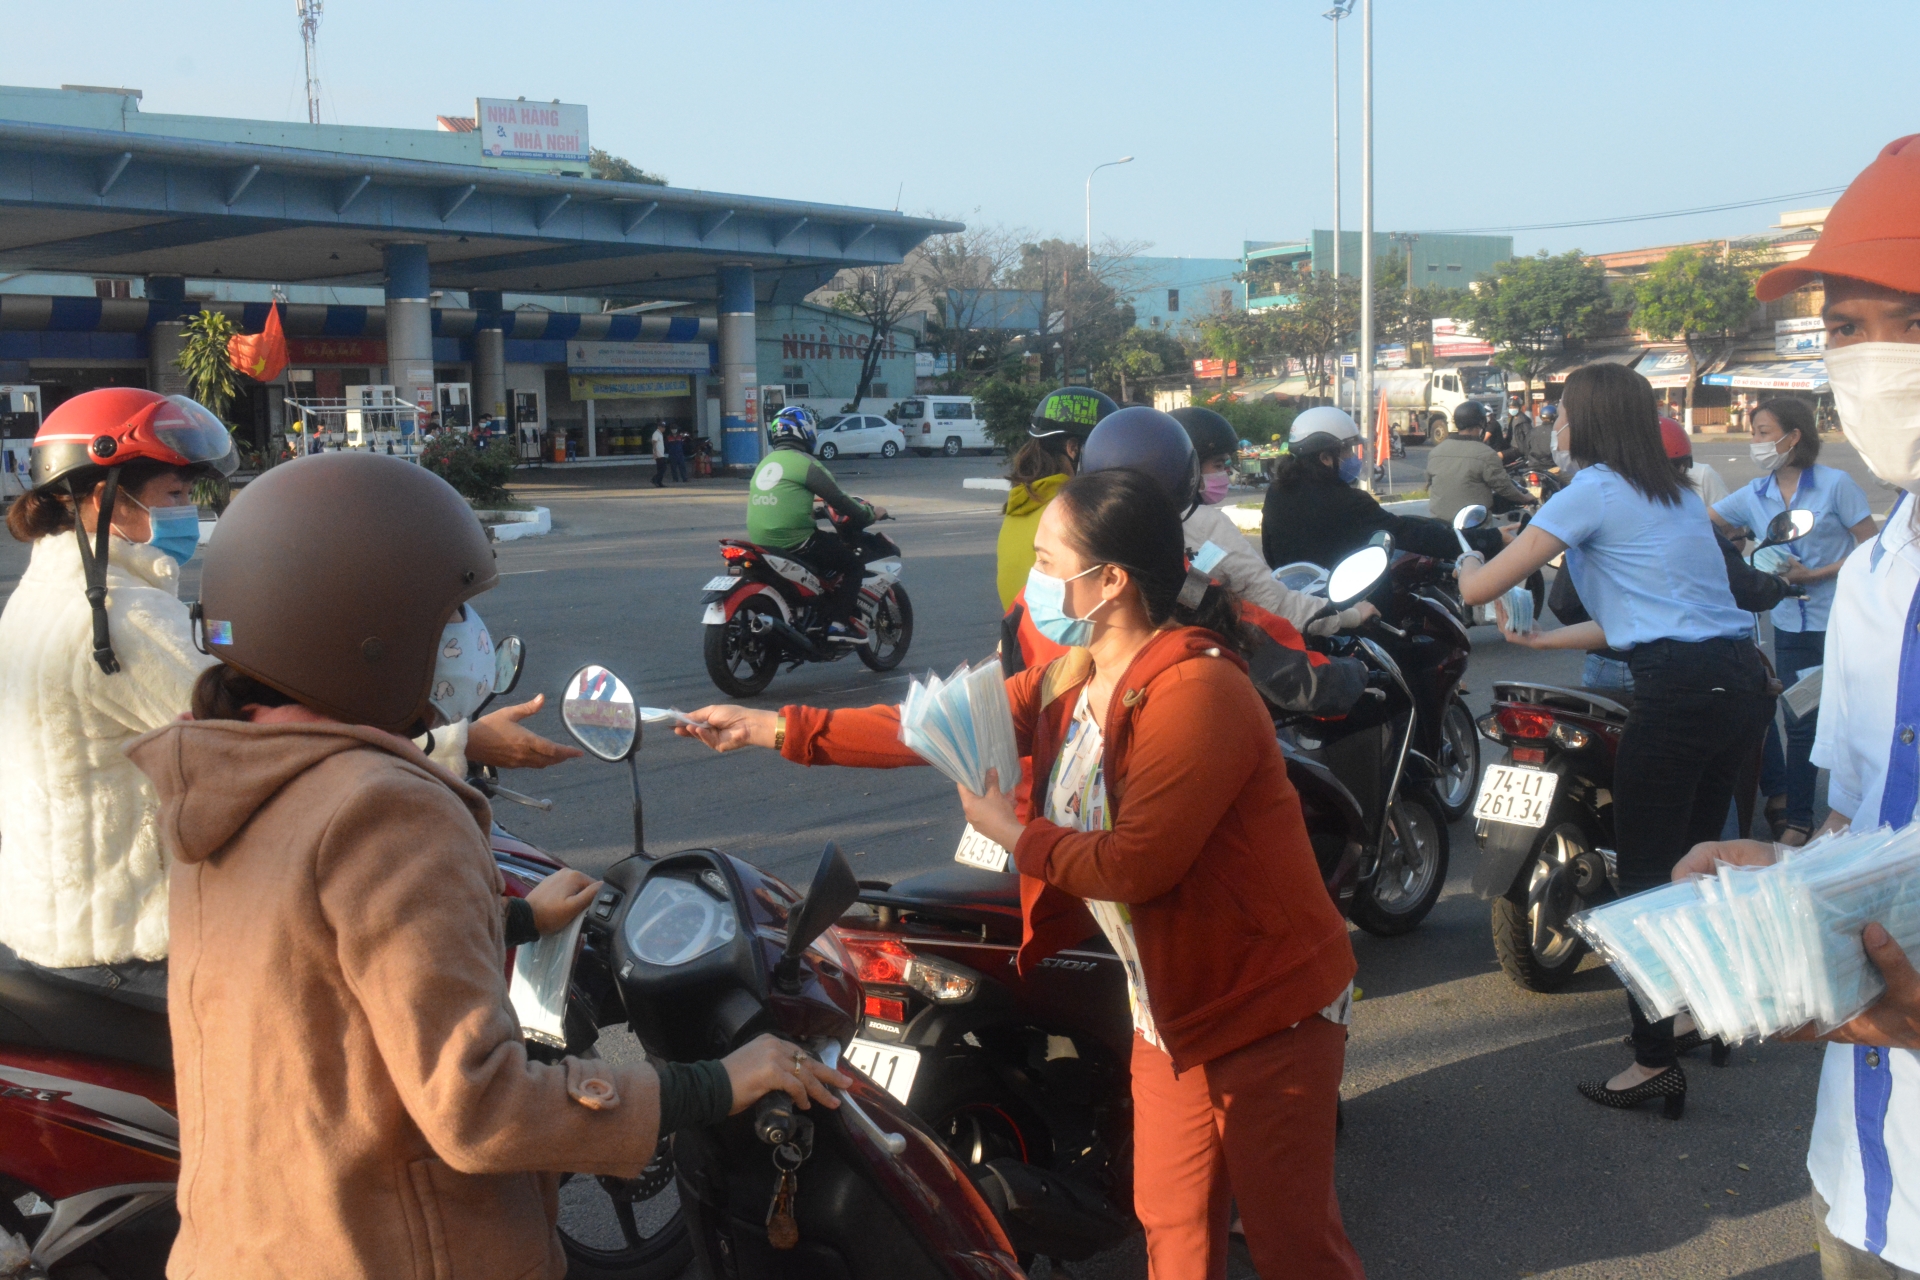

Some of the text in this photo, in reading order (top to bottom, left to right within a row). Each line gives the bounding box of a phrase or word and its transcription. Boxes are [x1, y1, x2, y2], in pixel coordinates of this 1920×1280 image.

[487, 104, 559, 127] NHÀ HÀNG
[497, 125, 507, 137] &
[513, 129, 579, 152] NHÀ NGHỈ
[783, 325, 832, 360] NHÀ
[1663, 354, 1688, 364] TOA
[1045, 396, 1099, 422] ROCK
[752, 492, 778, 506] Grab
[1493, 769, 1543, 797] 74-L1
[1480, 792, 1543, 822] 261.34
[959, 835, 1006, 867] 243.51
[868, 1021, 901, 1034] HONDA
